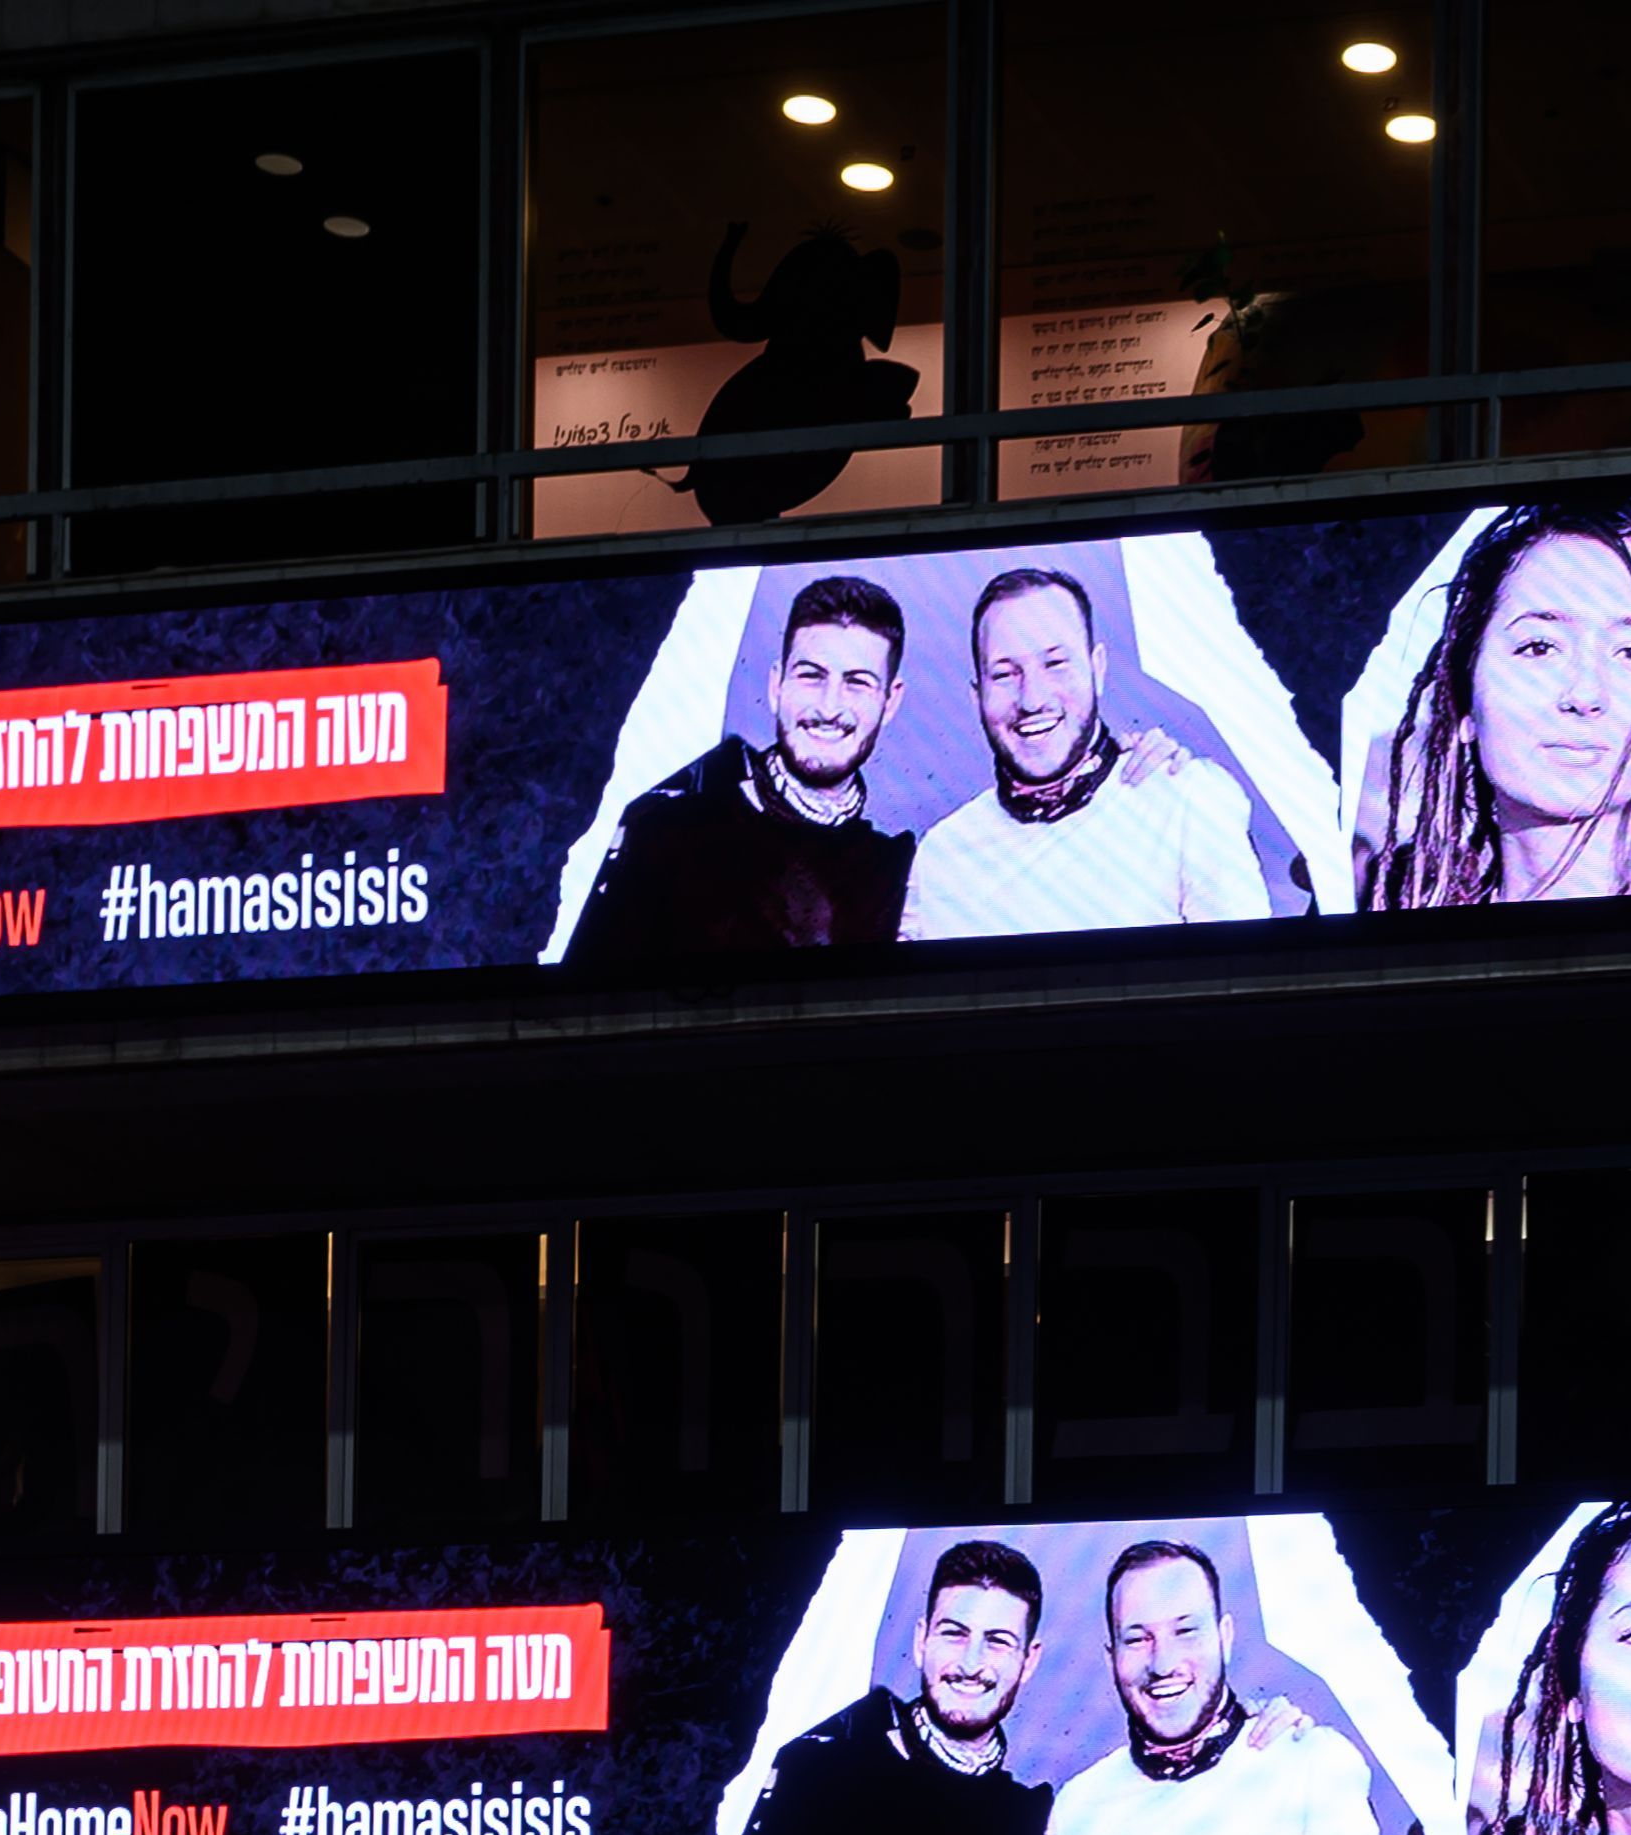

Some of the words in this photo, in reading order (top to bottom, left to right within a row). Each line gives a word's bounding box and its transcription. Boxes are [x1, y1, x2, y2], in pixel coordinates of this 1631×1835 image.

[99, 698, 305, 783] המשפחות
[316, 692, 407, 768] מטה
[99, 848, 429, 942] #hamasisisis
[120, 1638, 272, 1712] להחזרת
[279, 1636, 476, 1707] המשפחות
[484, 1633, 572, 1701] מטה
